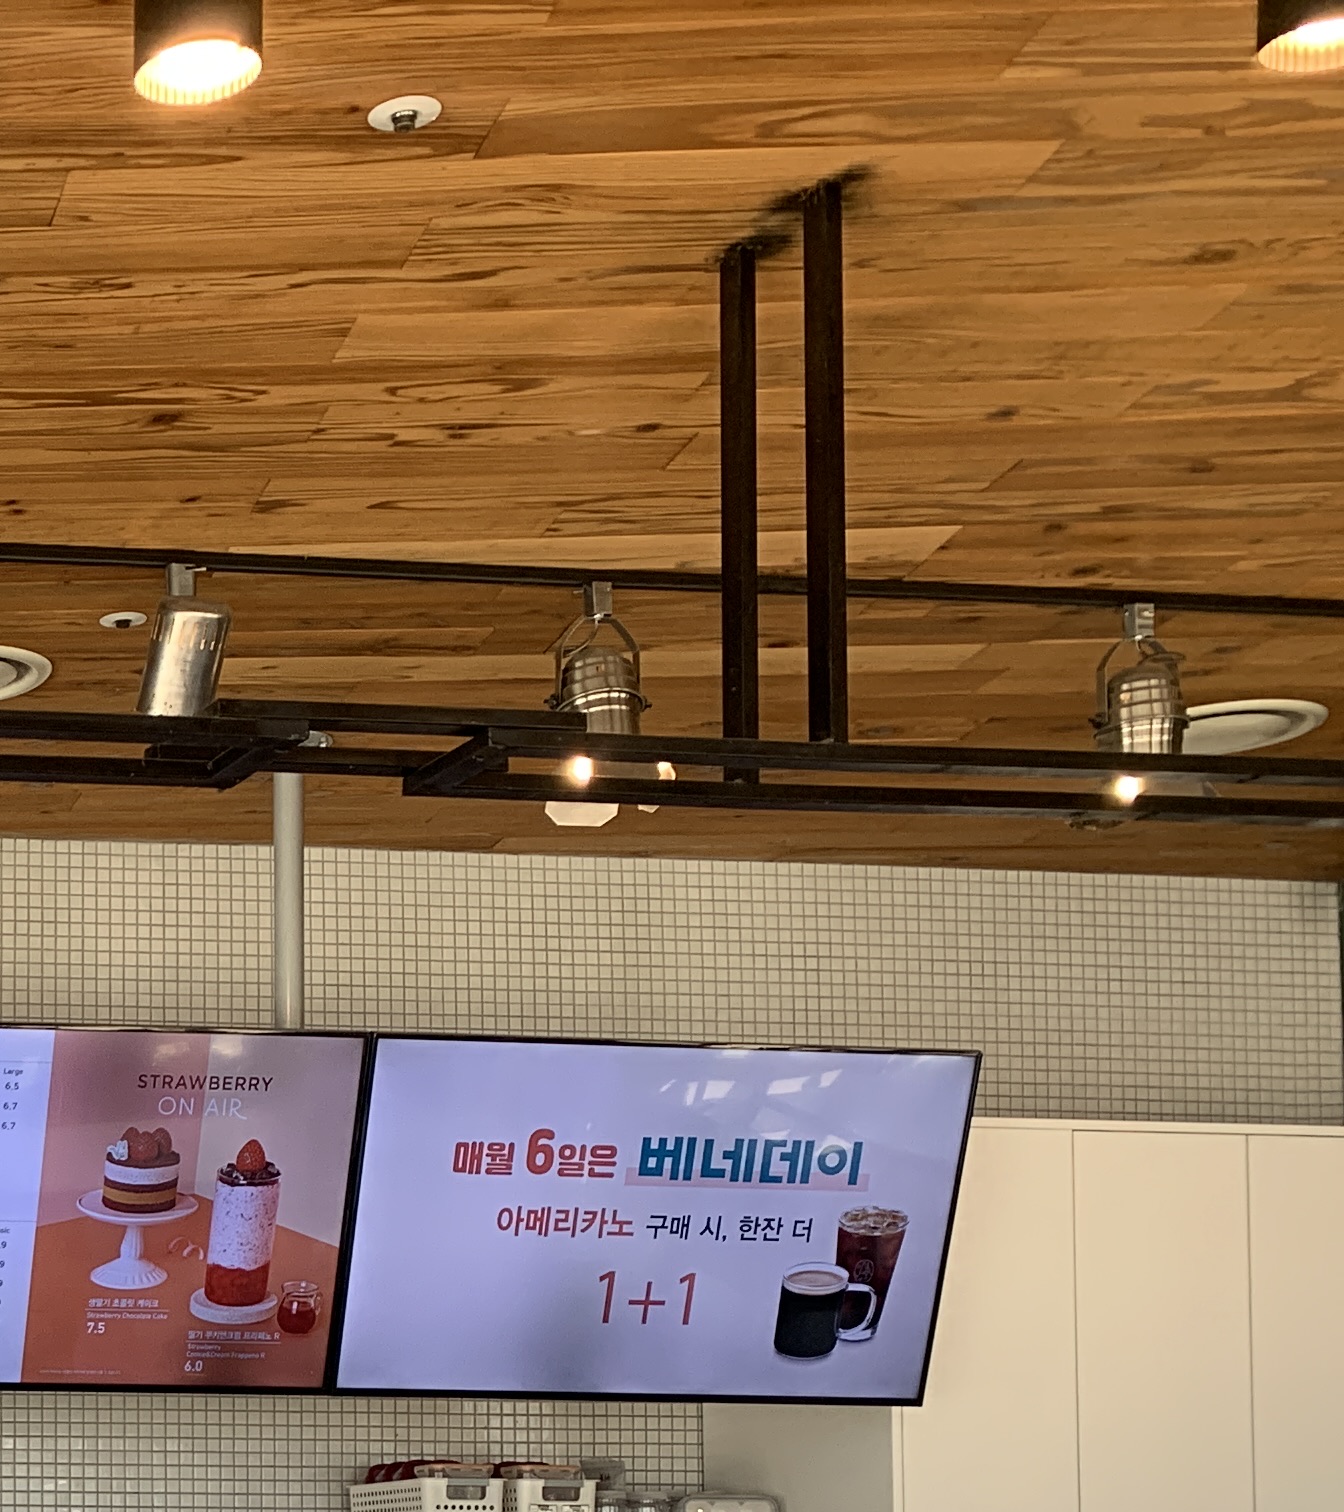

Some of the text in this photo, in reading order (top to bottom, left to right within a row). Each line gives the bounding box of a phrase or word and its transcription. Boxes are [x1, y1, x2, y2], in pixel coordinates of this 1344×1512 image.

[138, 1075, 273, 1091] STRAWBERRY
[159, 1097, 247, 1119] ON AIR
[453, 1128, 863, 1186] 매월 6일은 베네데이
[497, 1206, 813, 1244] 아메리카노 구매 시, 한잔 더
[598, 1270, 697, 1326] 1+1
[87, 1322, 105, 1334] 7.5
[185, 1361, 203, 1372] 6.0
